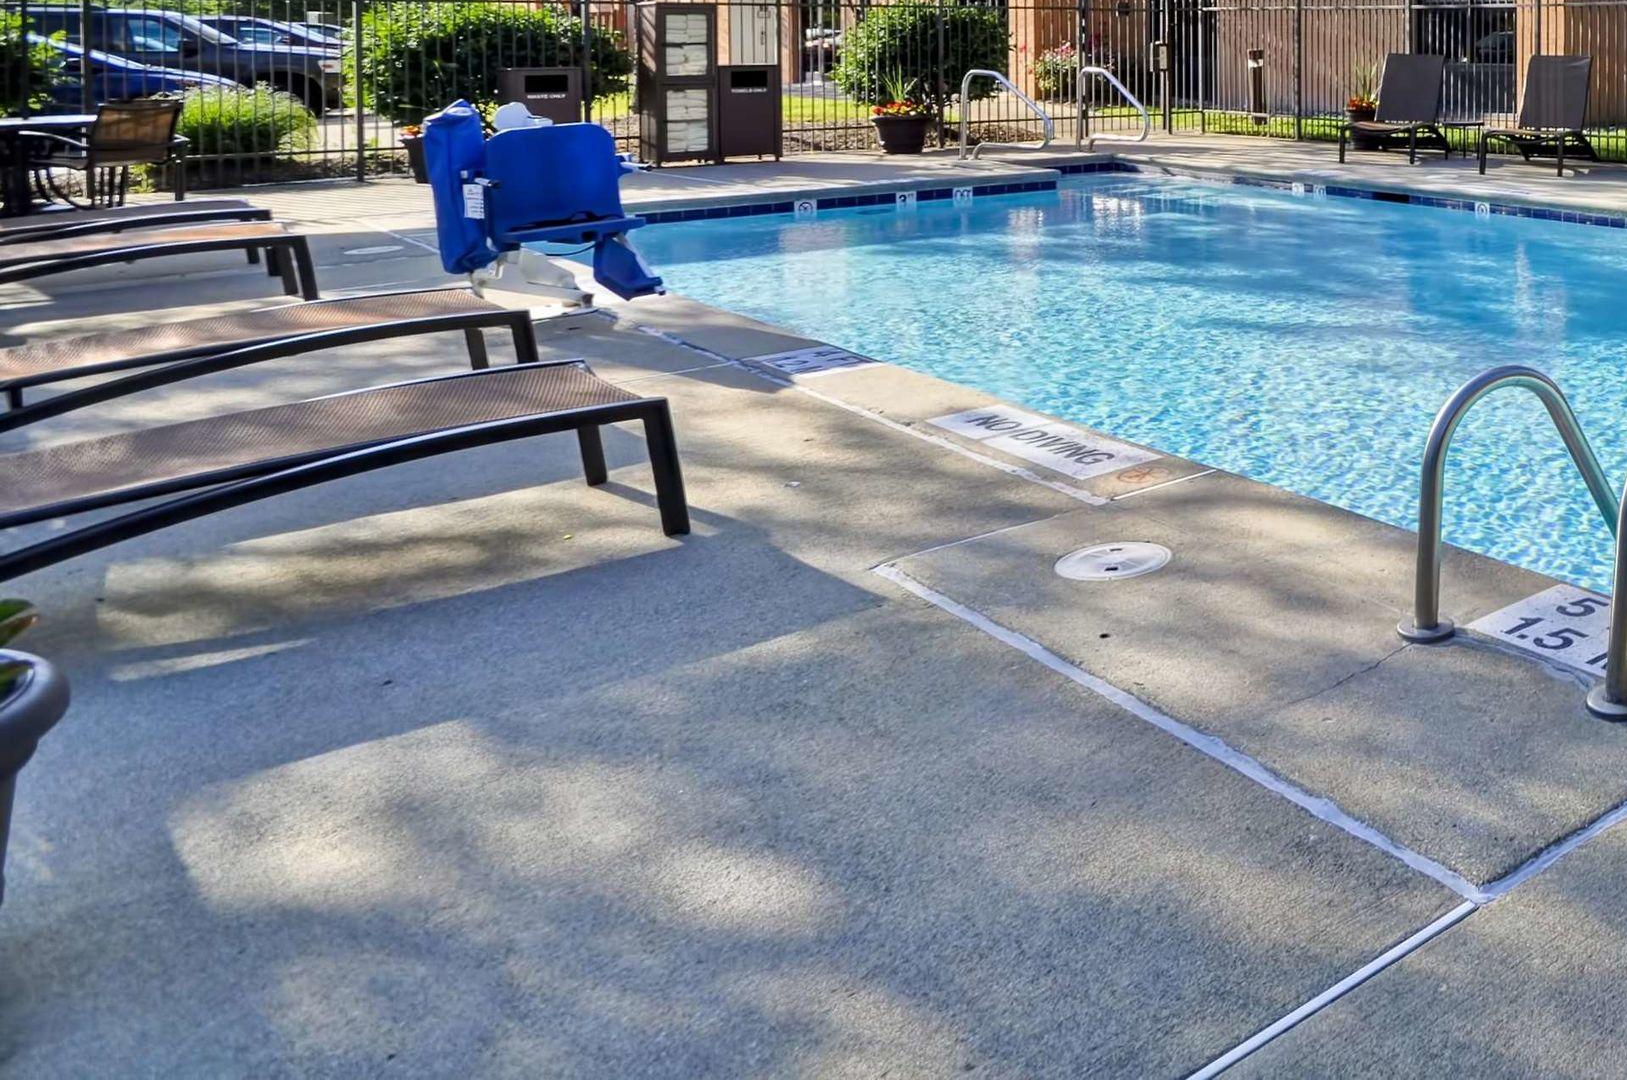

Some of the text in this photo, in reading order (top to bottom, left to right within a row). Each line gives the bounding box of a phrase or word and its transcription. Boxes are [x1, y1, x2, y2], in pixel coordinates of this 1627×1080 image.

[965, 414, 1116, 466] NO DIVING
[1557, 597, 1609, 618] 5
[1501, 616, 1590, 651] 1.5
